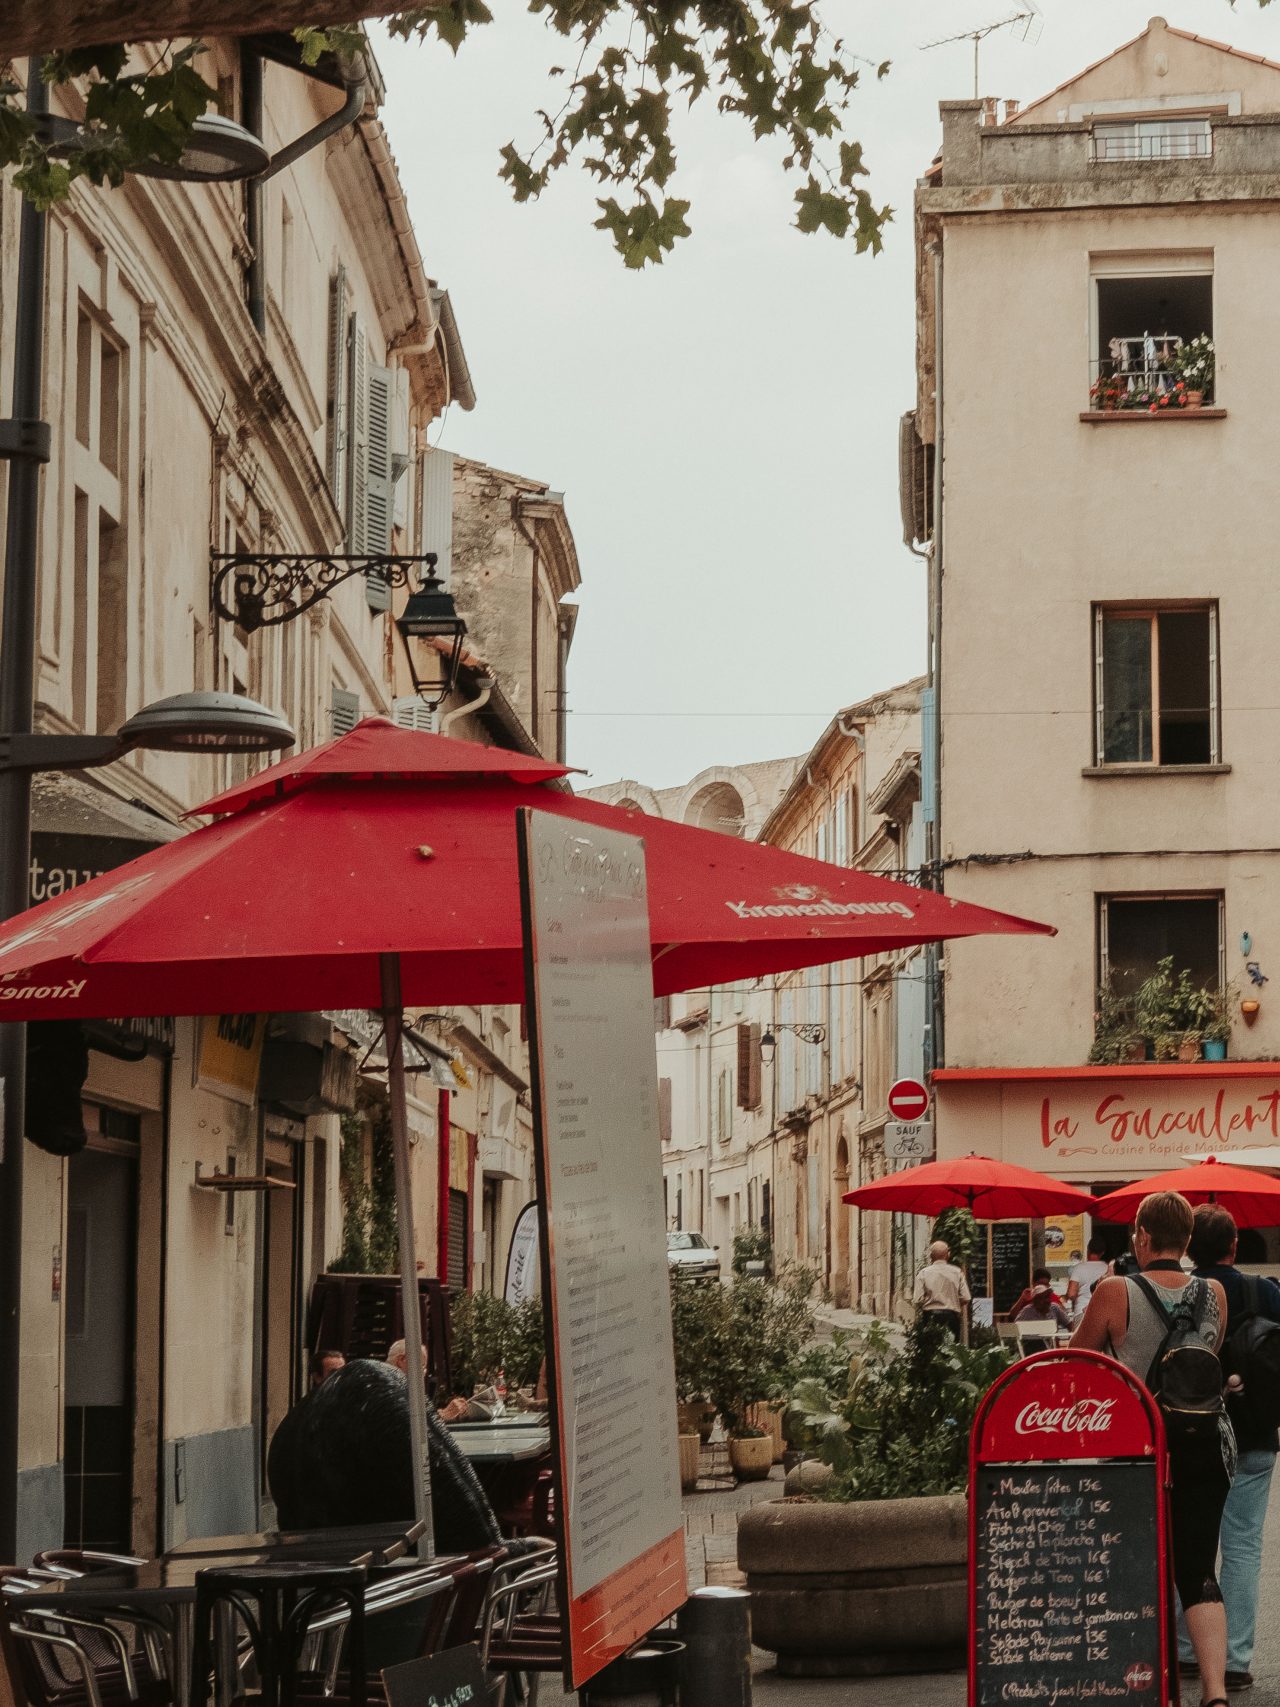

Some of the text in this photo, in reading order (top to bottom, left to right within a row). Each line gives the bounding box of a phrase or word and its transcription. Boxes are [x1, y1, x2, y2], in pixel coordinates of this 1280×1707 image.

[725, 898, 915, 920] Kronenbourg
[896, 1126, 922, 1135] SAUF
[1041, 1096, 1080, 1148] La
[1101, 1141, 1239, 1157] Cuisine Rapide Maison
[1015, 1398, 1118, 1435] Coca-Cola
[1000, 1476, 1042, 1496] Moules
[1043, 1475, 1072, 1504] frites
[988, 1521, 1013, 1537] Fish
[1015, 1519, 1036, 1534] and
[1037, 1520, 1066, 1536] Chips
[1039, 1535, 1052, 1549] la
[1035, 1553, 1050, 1567] de
[987, 1570, 1029, 1597] Burger
[1031, 1571, 1046, 1585] de
[987, 1591, 1028, 1615] Burger
[1029, 1596, 1044, 1608] de
[1086, 1591, 1107, 1607] 12€
[1027, 1617, 1044, 1629] au
[1072, 1614, 1084, 1626] et
[989, 1631, 1030, 1651] Salade
[1086, 1628, 1107, 1644] 13€
[987, 1649, 1024, 1666] Salade
[1087, 1646, 1110, 1661] 13€
